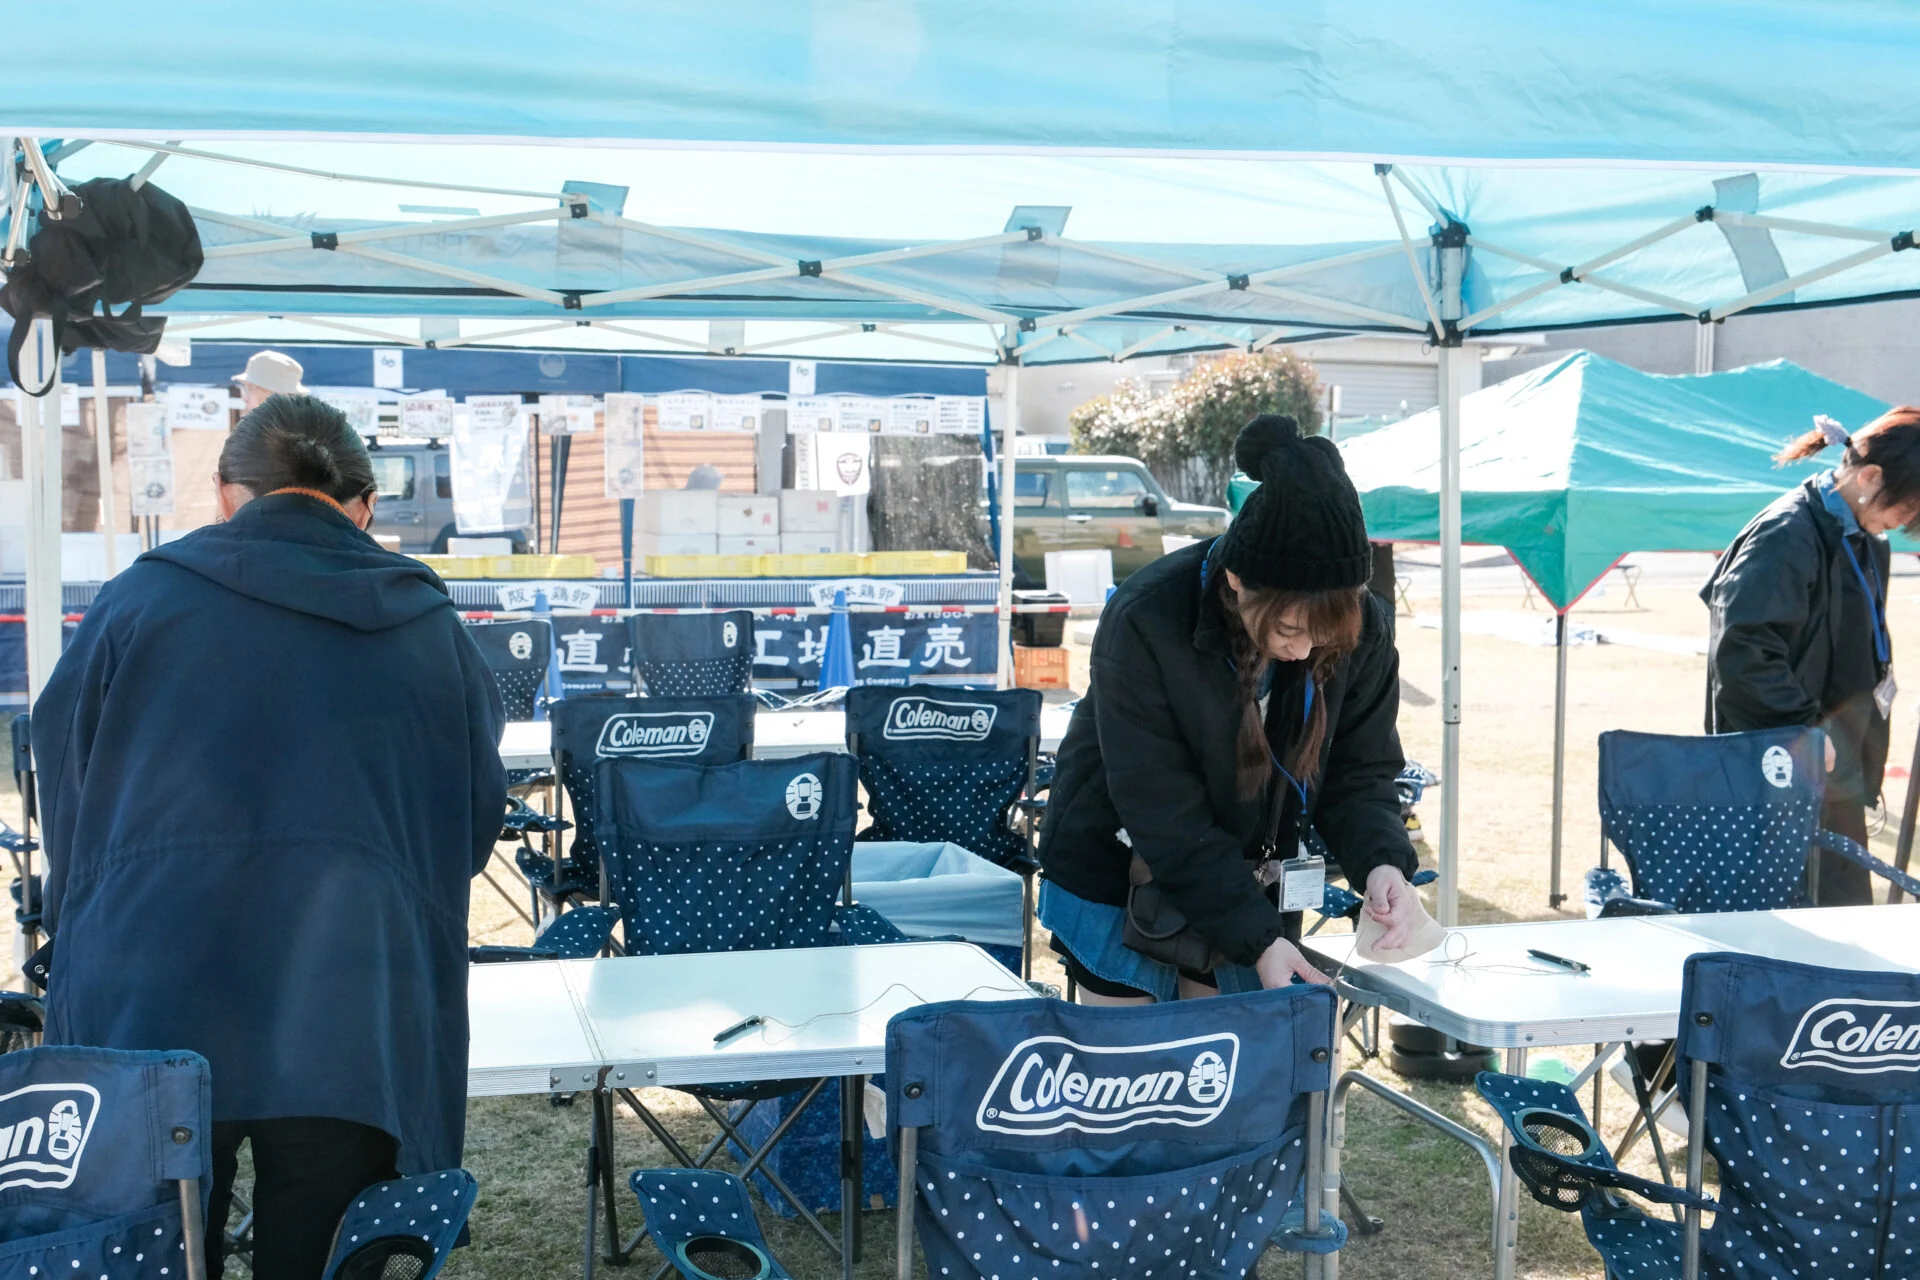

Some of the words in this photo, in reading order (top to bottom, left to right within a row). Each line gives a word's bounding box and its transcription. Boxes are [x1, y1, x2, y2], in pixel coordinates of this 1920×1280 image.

[556, 629, 633, 673] 直
[609, 719, 688, 747] Coleman
[895, 702, 970, 731] Coleman
[1009, 1052, 1185, 1112] Coleman
